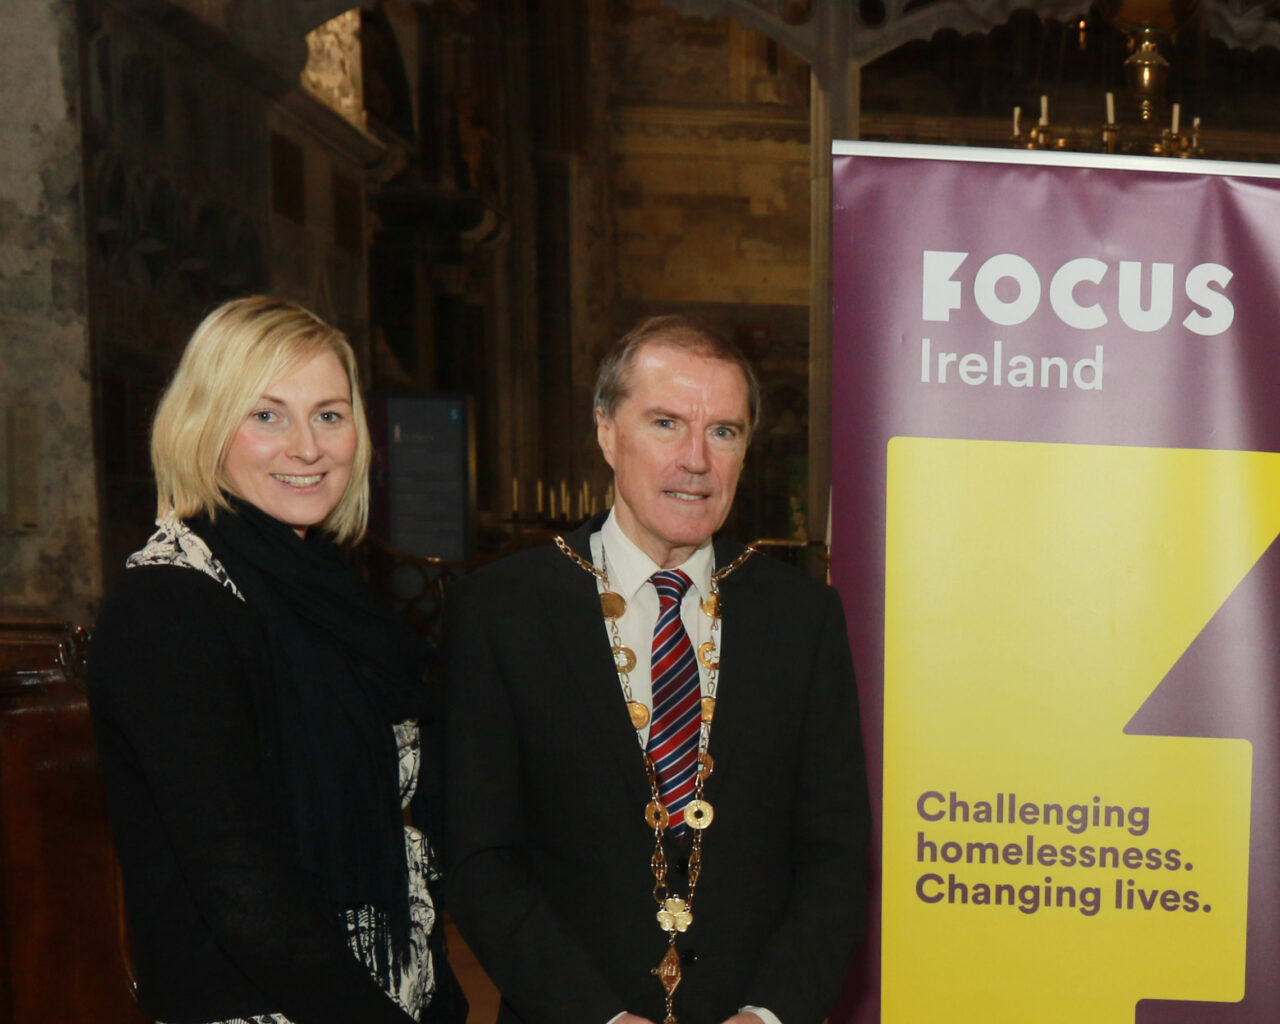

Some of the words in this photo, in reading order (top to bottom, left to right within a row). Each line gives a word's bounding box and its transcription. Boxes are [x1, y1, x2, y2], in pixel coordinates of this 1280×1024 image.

[921, 250, 1235, 337] FOCUS
[920, 337, 1104, 391] Ireland
[916, 790, 1150, 837] Challenging
[916, 831, 1194, 872] homelessness.
[915, 872, 1101, 917] Changing
[1115, 878, 1212, 914] lives.
